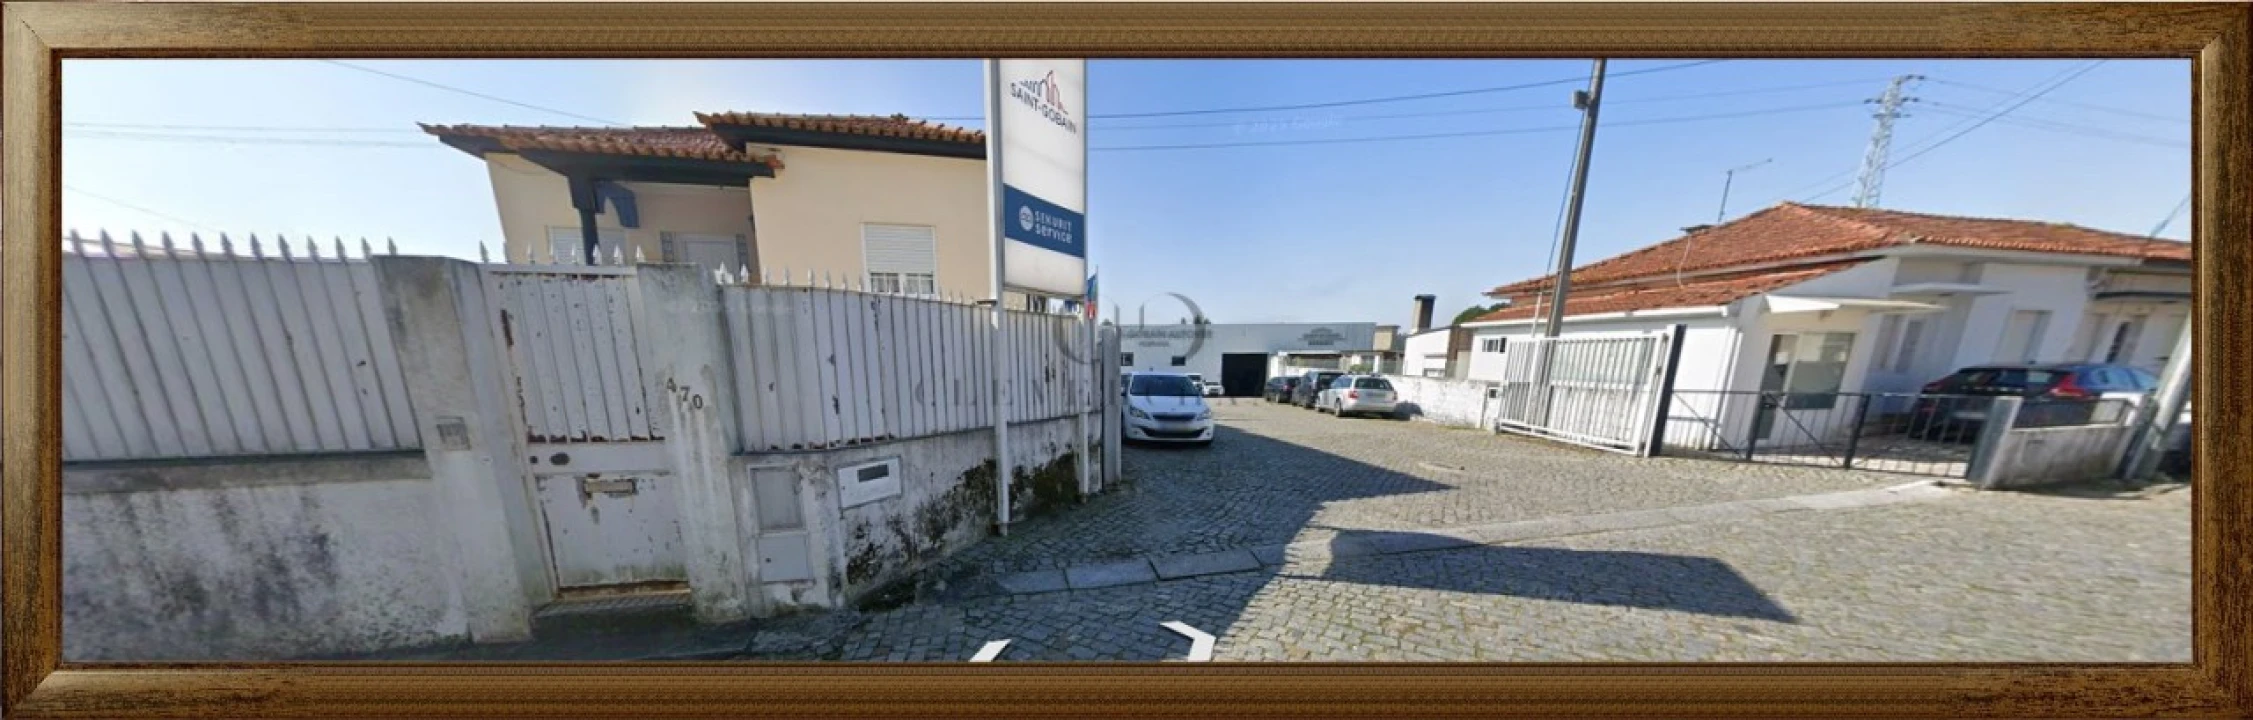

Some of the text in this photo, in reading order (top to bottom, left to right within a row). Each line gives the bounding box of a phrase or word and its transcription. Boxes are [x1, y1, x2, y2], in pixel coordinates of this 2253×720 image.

[1010, 82, 1077, 134] SAINT-GOBAIN
[1034, 210, 1073, 233] SEKURIT
[666, 377, 703, 409] 470
